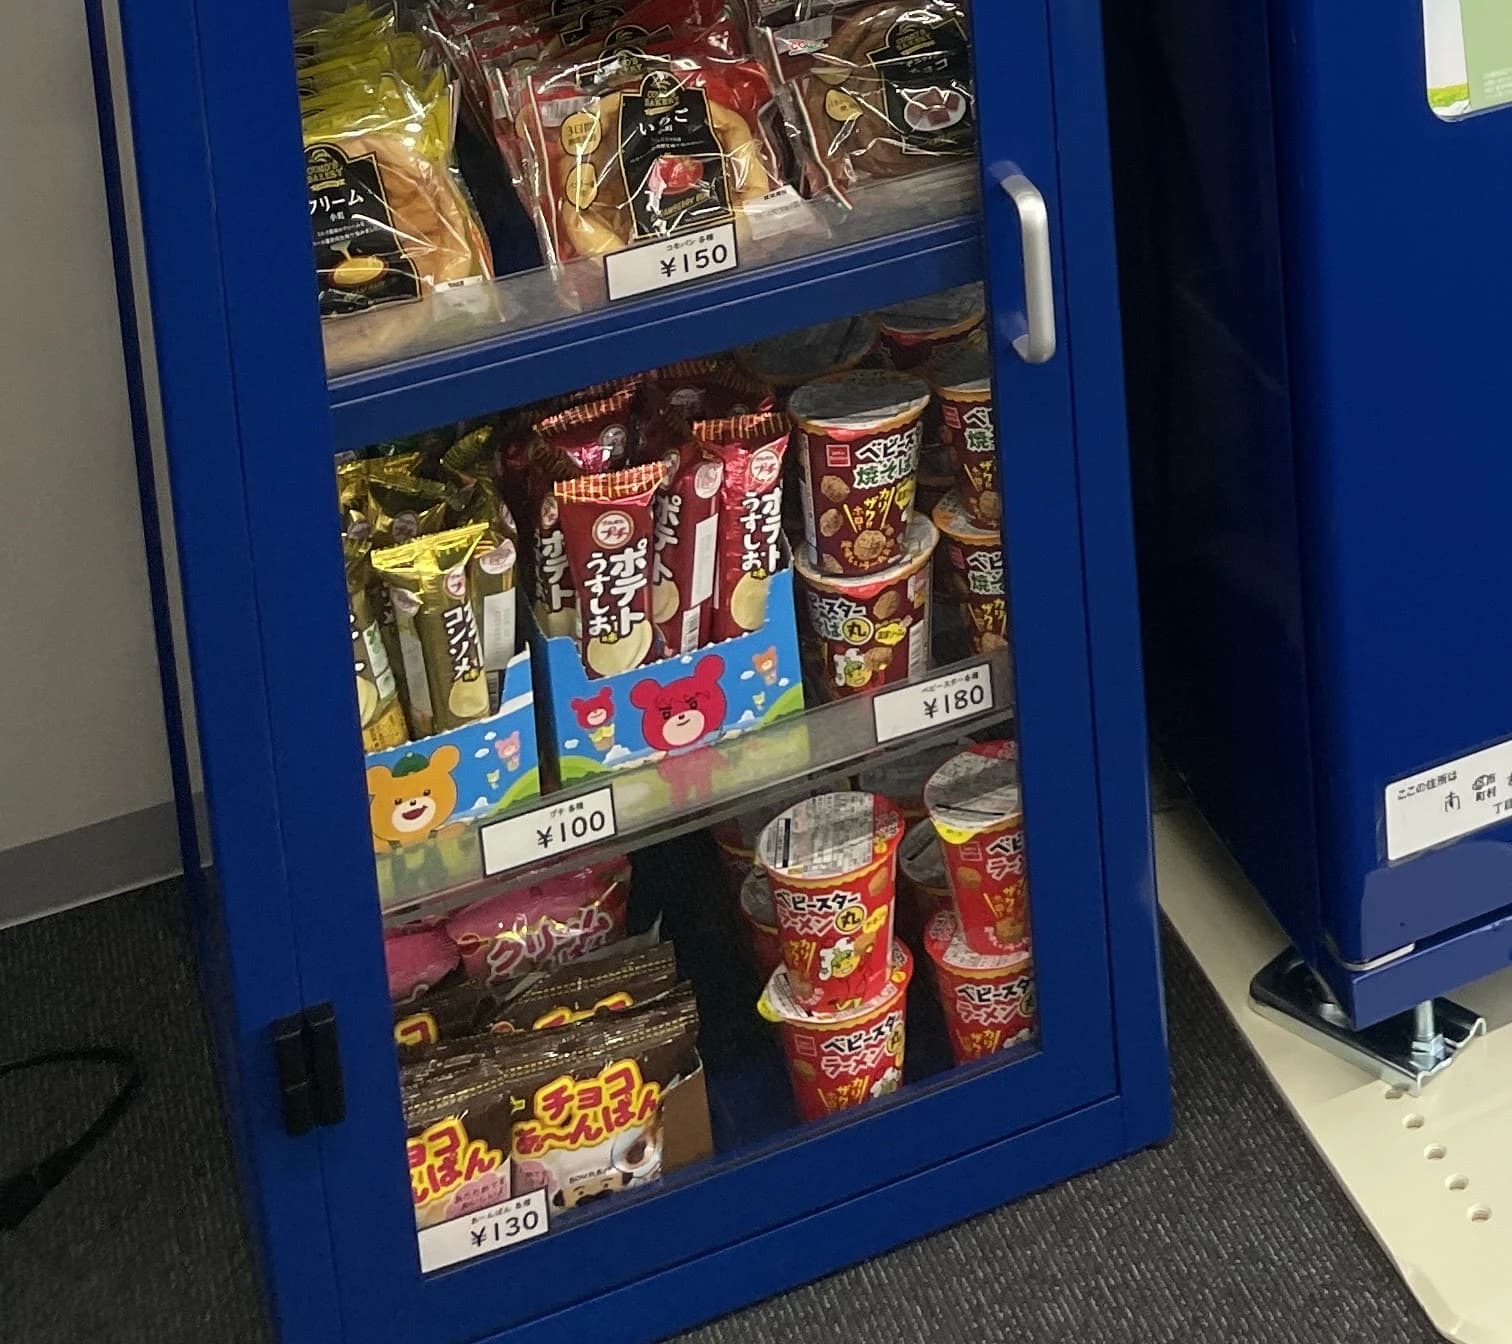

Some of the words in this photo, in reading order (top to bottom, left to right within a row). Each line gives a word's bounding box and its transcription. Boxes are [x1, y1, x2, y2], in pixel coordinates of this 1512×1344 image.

[660, 244, 727, 277] ¥150
[739, 491, 767, 571] うすしお
[584, 553, 618, 637] うすしお
[609, 537, 648, 636] ポテト
[923, 685, 985, 719] ¥180
[537, 811, 605, 848] ¥100
[542, 1067, 636, 1120] チョコ
[471, 1211, 538, 1247] ¥130
